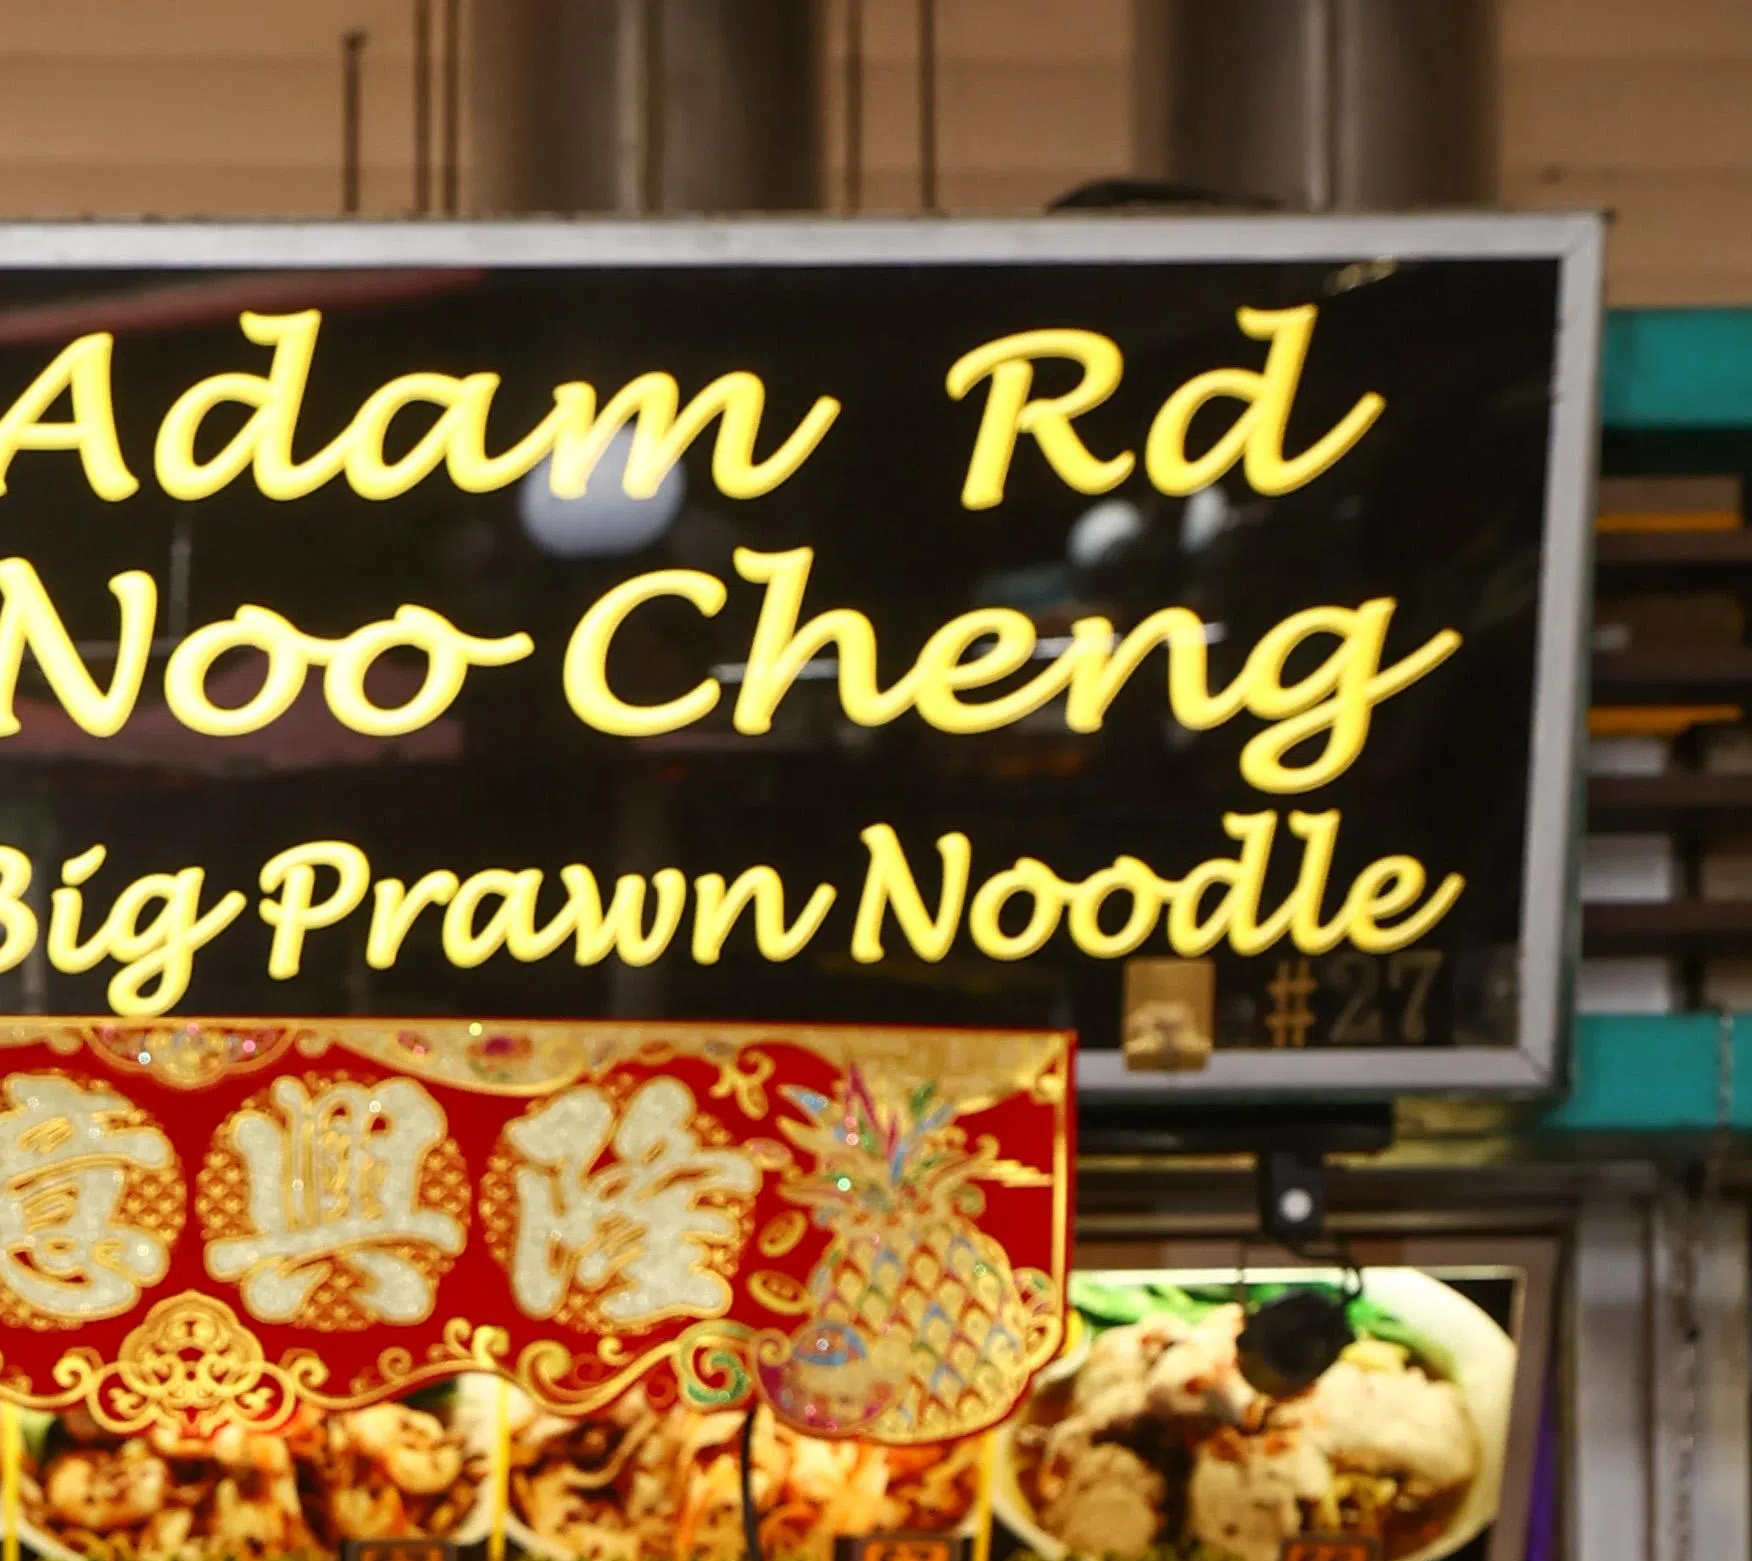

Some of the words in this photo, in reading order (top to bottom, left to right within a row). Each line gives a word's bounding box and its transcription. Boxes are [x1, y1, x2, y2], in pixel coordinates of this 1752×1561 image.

[944, 303, 1385, 510] Rd
[562, 544, 1463, 796] Cheng
[257, 839, 835, 980] Prawn
[851, 808, 1463, 966] Noodle
[1264, 949, 1444, 1049] #27
